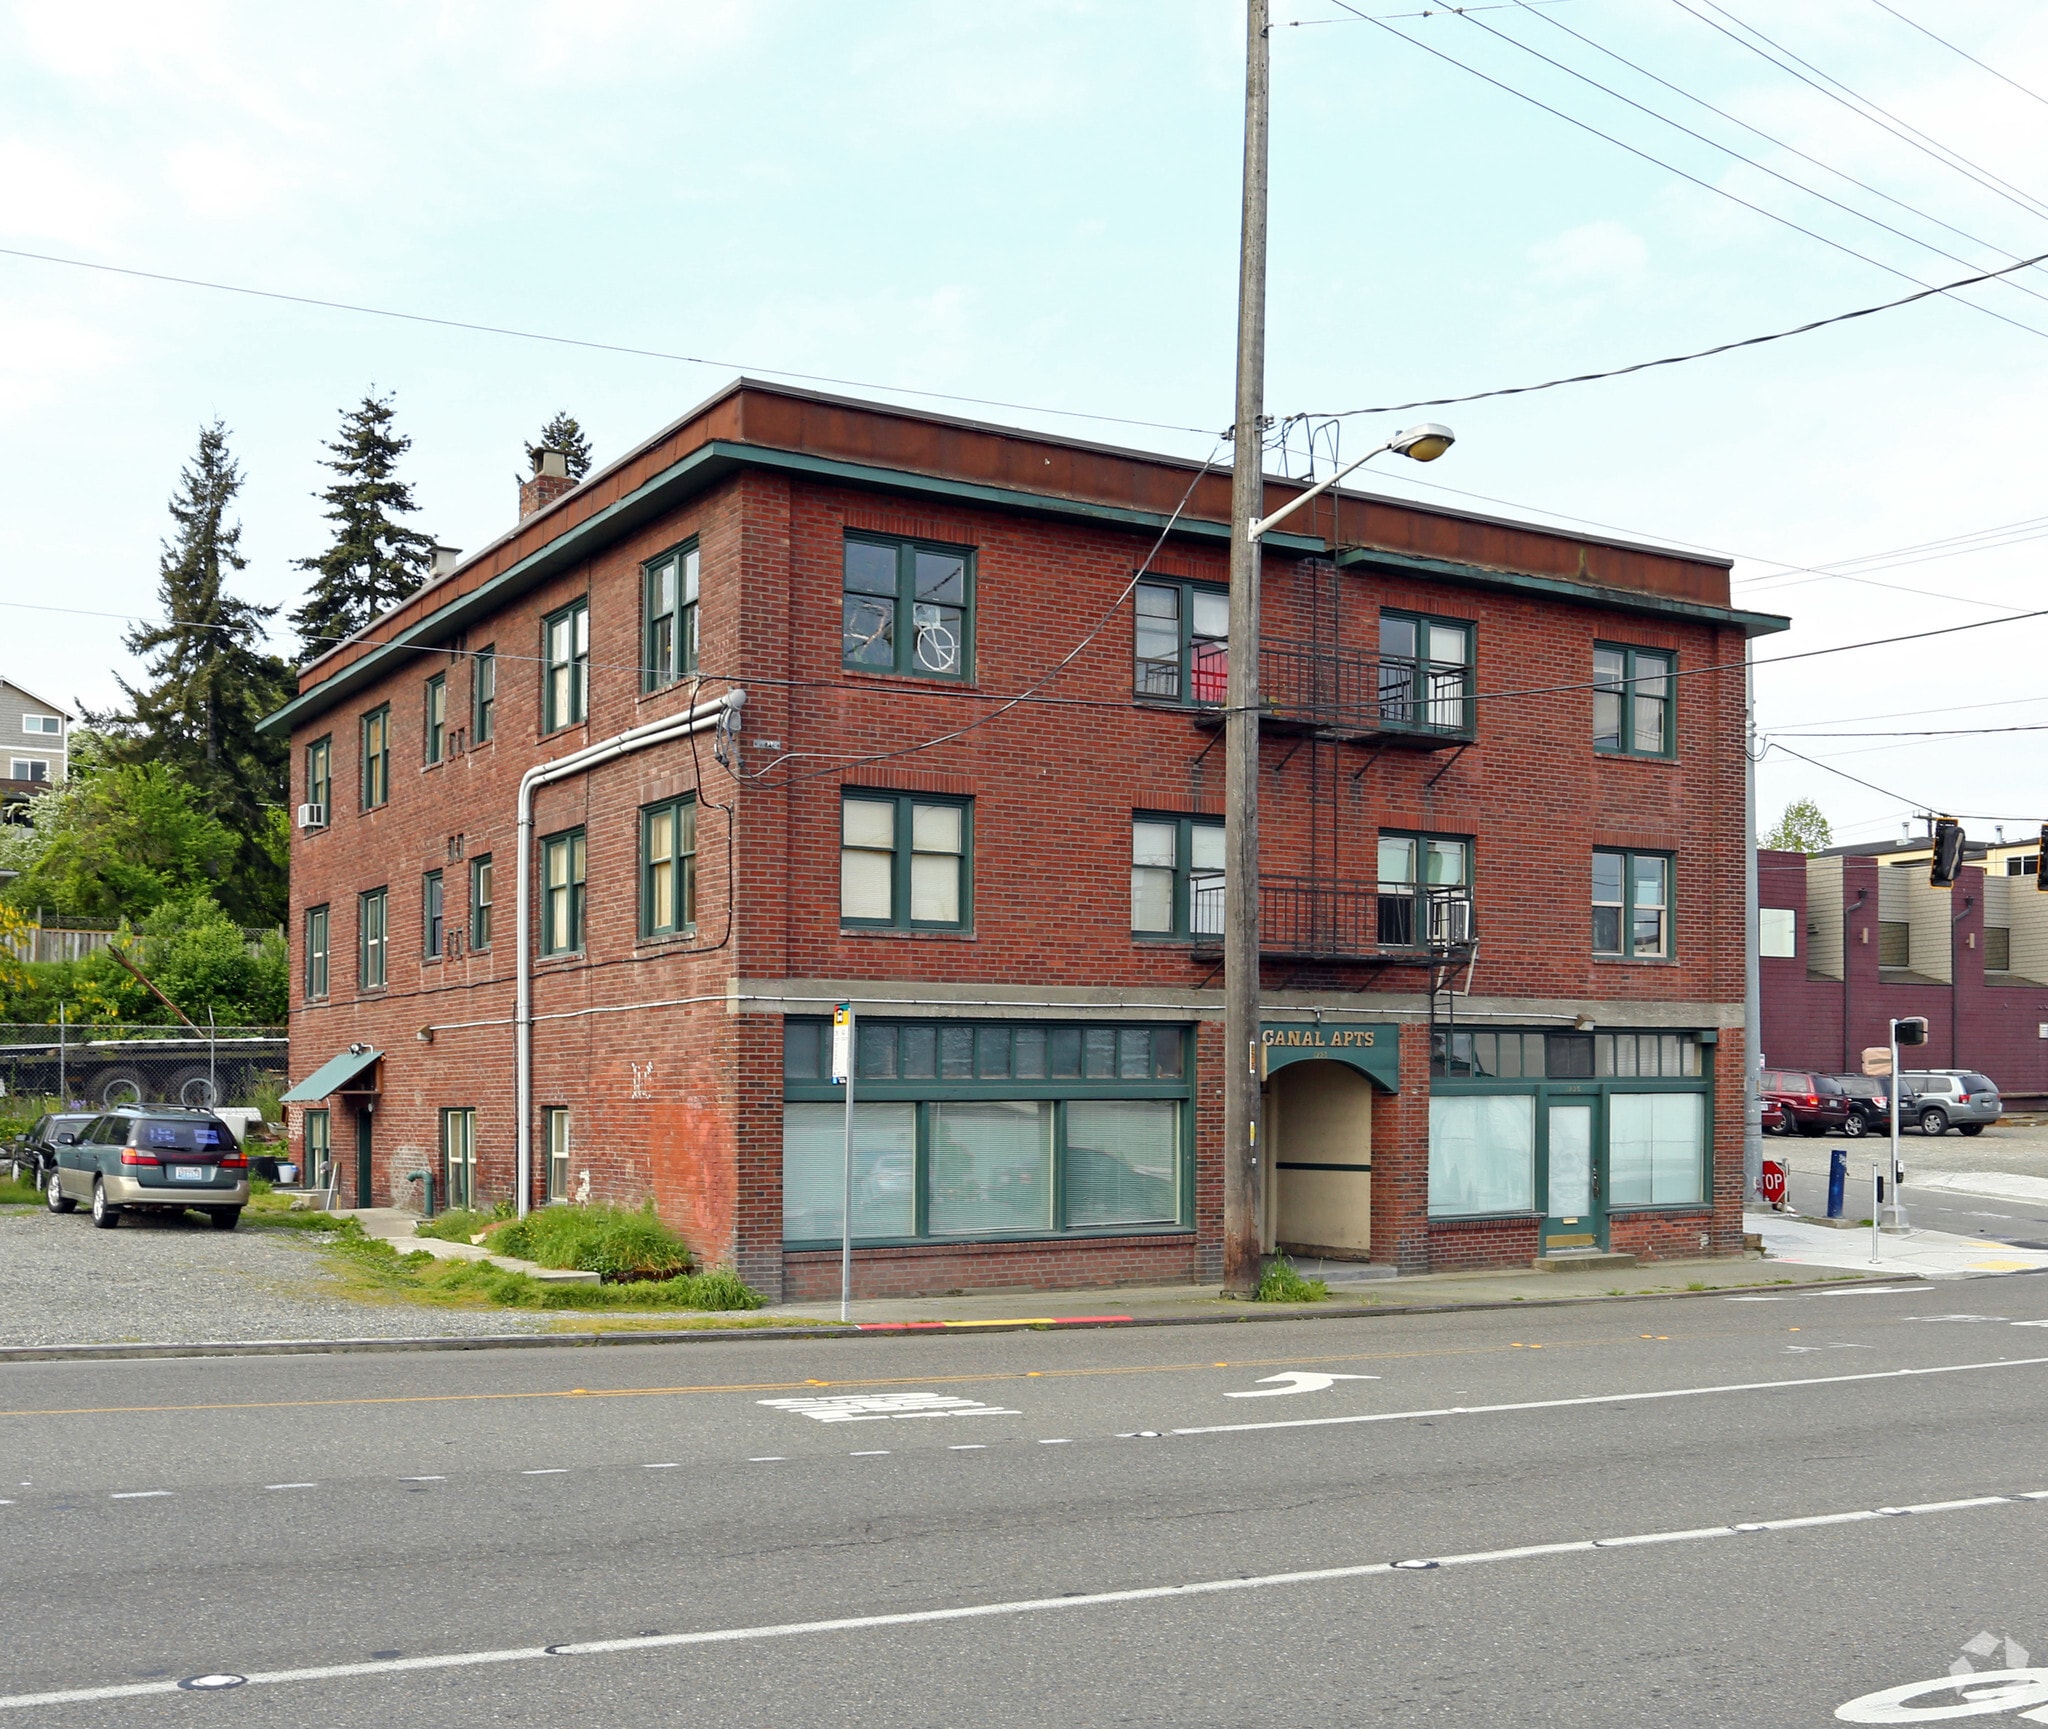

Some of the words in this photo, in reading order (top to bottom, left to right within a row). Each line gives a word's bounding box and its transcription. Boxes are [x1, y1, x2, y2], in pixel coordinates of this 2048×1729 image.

[1262, 1029, 1325, 1046] CANAL
[1330, 1031, 1374, 1046] APTS
[1762, 1173, 1782, 1190] OP
